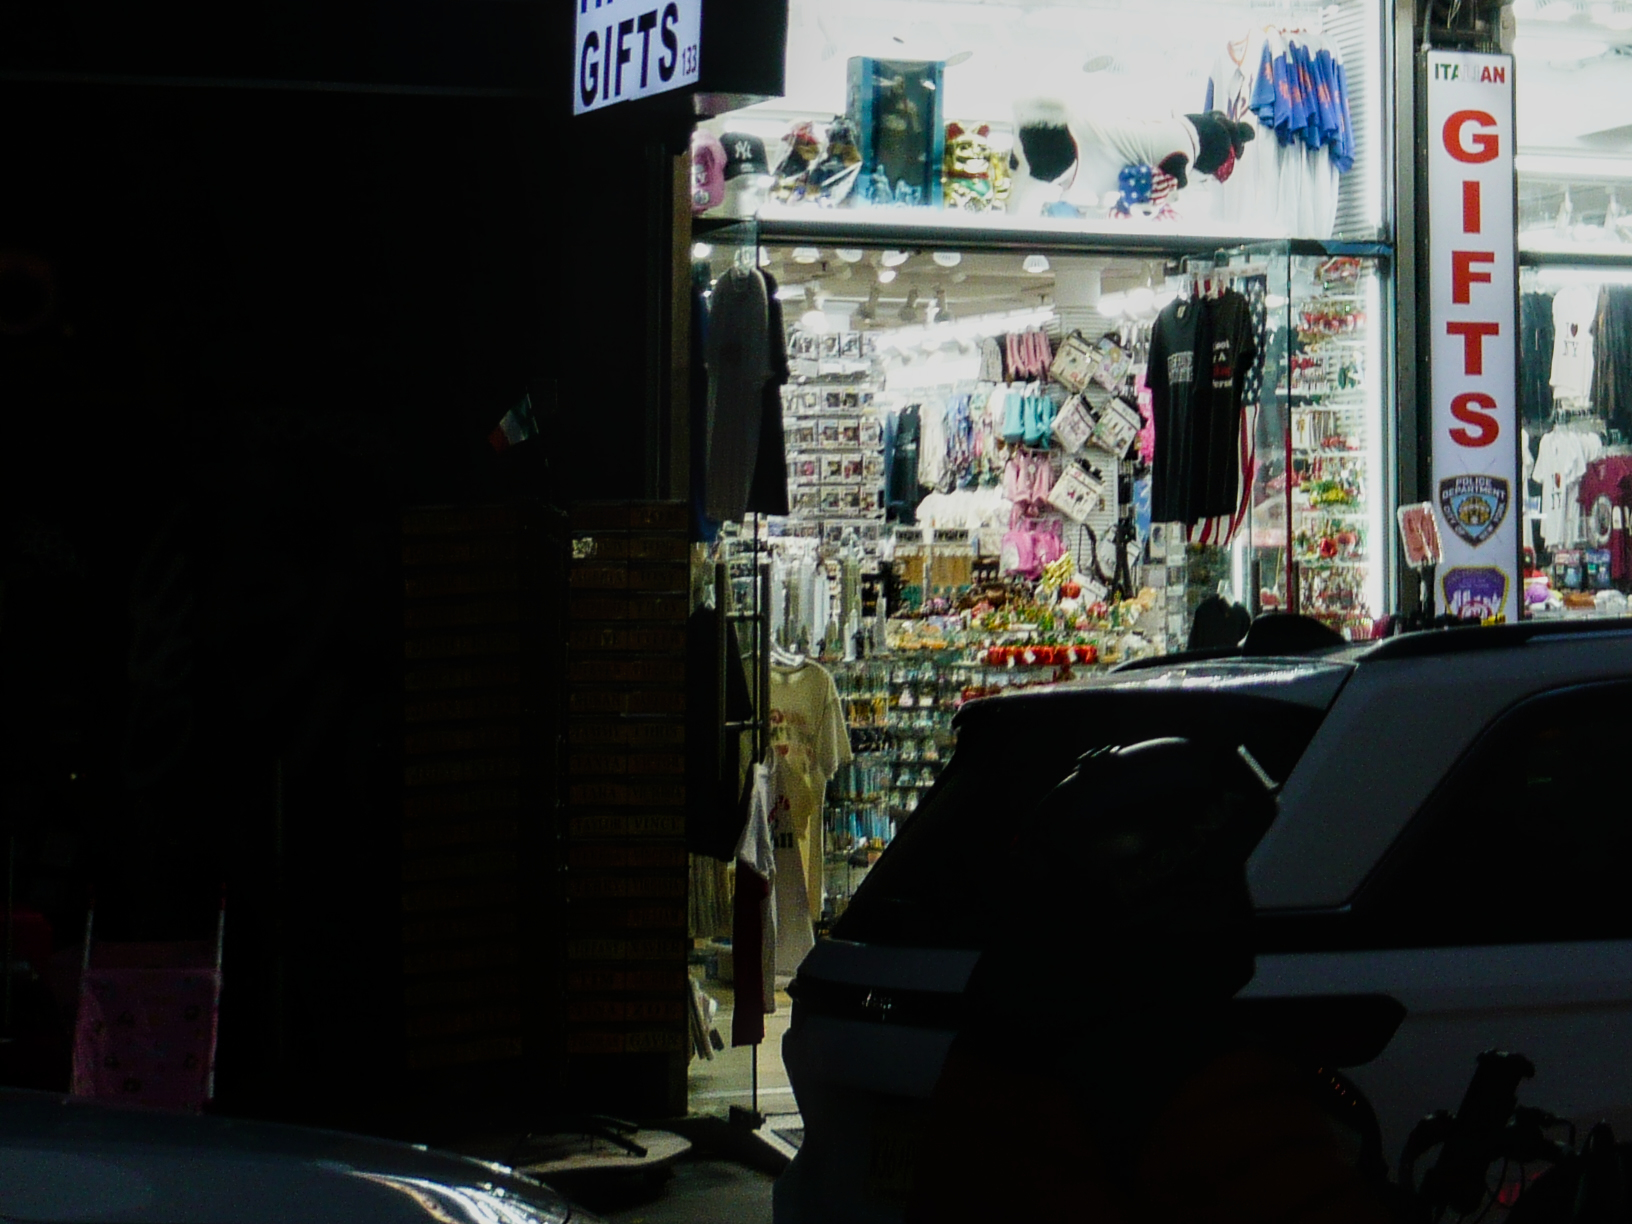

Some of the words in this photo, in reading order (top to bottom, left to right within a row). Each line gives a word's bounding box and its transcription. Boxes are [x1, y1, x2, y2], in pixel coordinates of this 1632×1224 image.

[580, 1, 679, 108] GIFTS
[681, 44, 698, 77] 133
[1441, 109, 1500, 449] GIFTS
[1442, 485, 1506, 500] DEPARTMENT
[1456, 476, 1492, 487] POLICE
